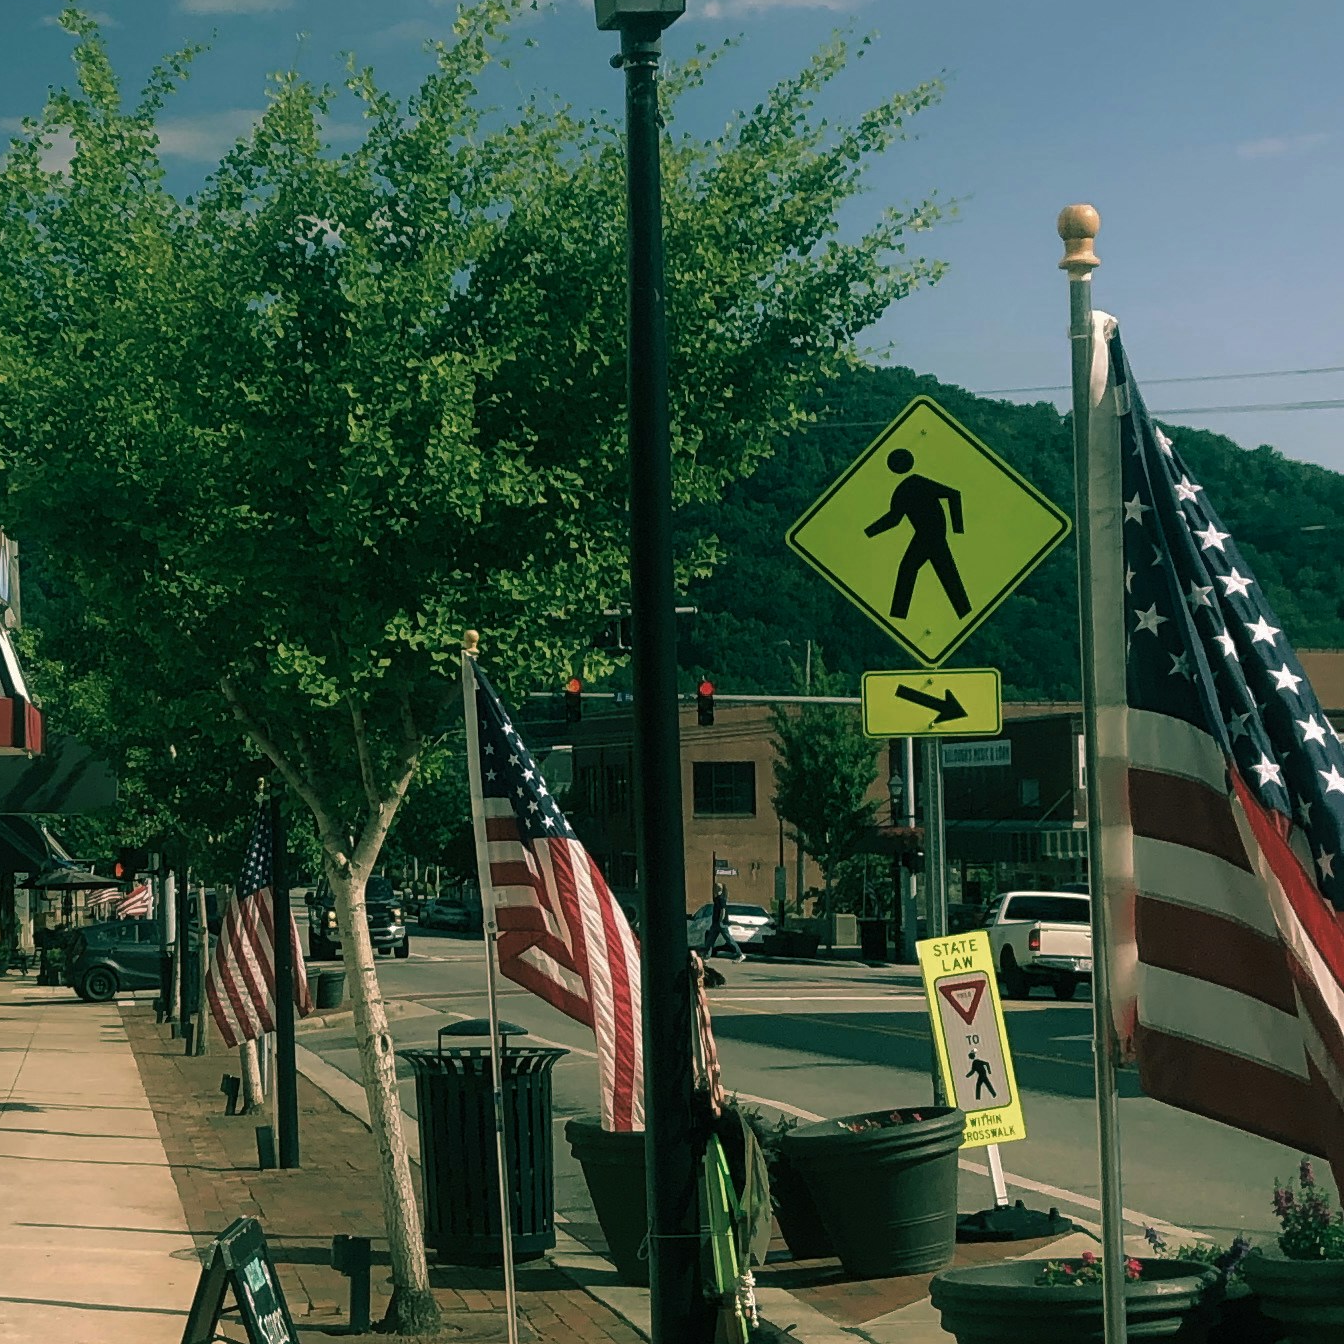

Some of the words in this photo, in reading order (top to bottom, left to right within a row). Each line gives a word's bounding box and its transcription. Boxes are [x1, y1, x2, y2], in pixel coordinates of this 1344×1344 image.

[933, 939, 978, 957] STATE
[942, 955, 973, 972] LAW
[965, 1034, 980, 1046] TO
[969, 1113, 1003, 1128] WITHIN
